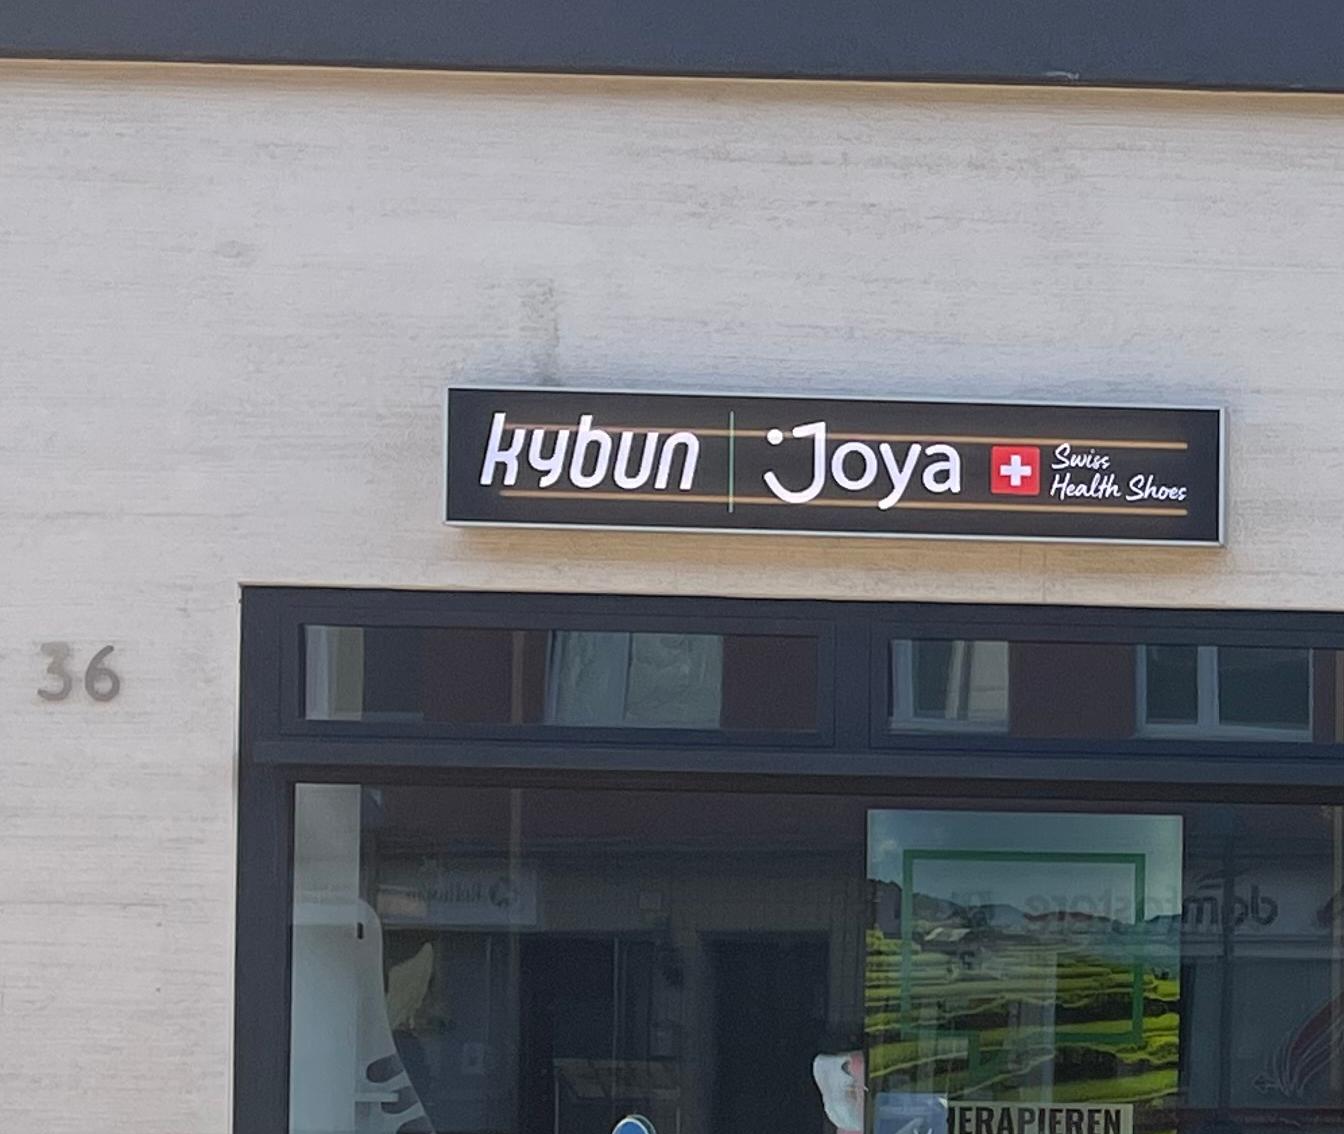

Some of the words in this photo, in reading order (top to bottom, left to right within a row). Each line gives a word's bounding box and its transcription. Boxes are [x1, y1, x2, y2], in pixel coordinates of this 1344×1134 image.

[480, 412, 700, 490] kybun
[764, 421, 962, 509] Joya
[1052, 443, 1111, 469] Swiss
[1050, 472, 1122, 501] Health
[1126, 474, 1188, 501] Shoes
[37, 642, 120, 702] 36
